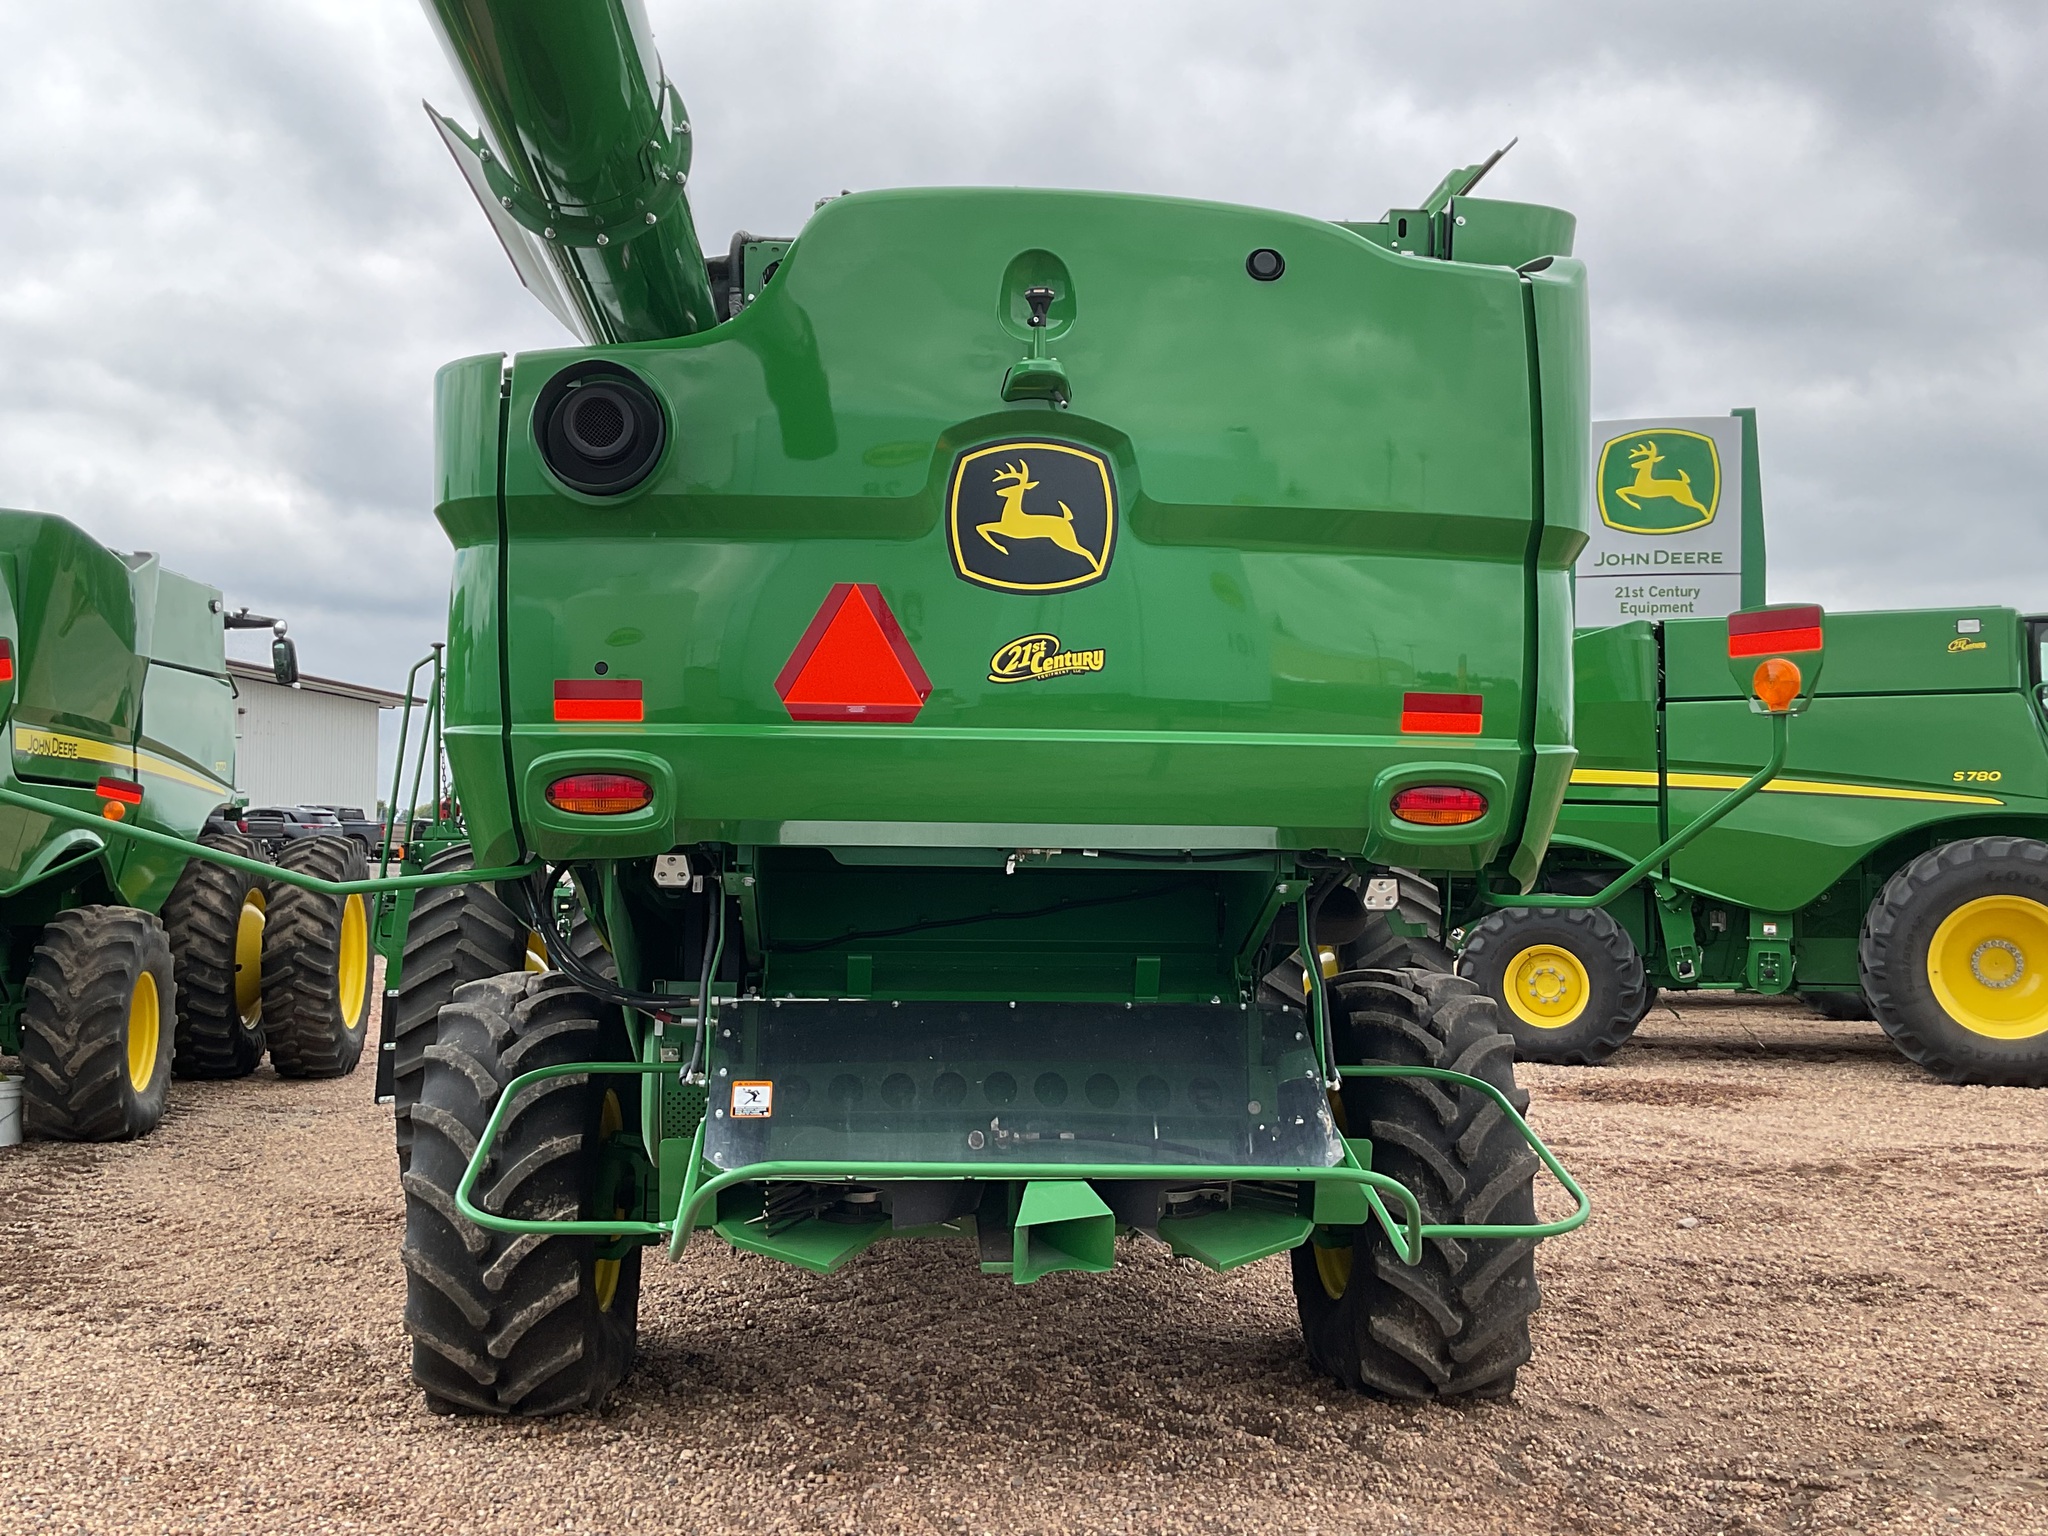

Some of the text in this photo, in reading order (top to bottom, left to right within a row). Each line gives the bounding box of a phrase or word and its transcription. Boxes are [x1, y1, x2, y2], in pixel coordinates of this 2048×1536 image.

[1593, 549, 1723, 567] JOHN DEERE
[1614, 585, 1701, 600] 21st Century
[1619, 601, 1695, 616] Equipment
[27, 734, 78, 757] JOHN DEERE
